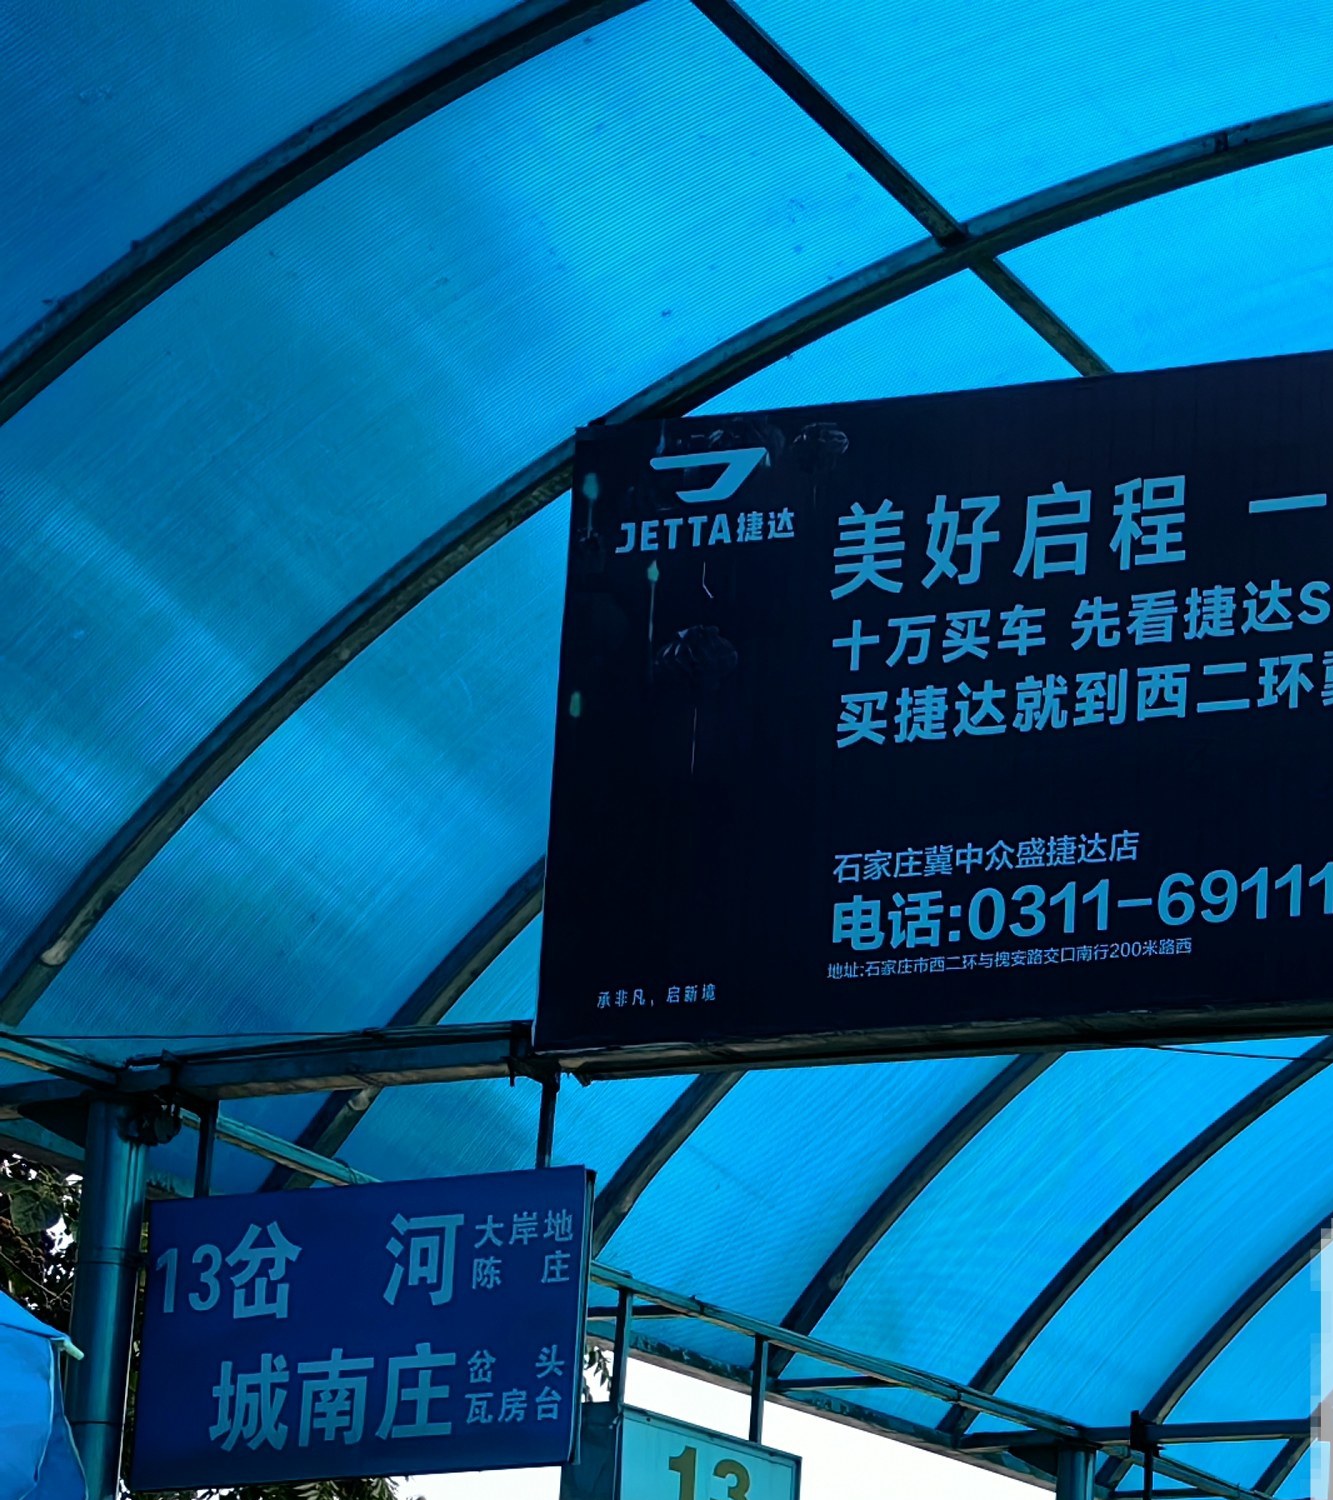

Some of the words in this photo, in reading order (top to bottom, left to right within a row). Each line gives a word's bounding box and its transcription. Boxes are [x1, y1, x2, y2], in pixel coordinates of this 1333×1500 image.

[830, 474, 1186, 599] 美好启程
[832, 603, 1047, 674] 十万买车
[833, 830, 1140, 883] 石家庄冀中众盛捷达店
[474, 1208, 574, 1250] 大岸地
[472, 1250, 571, 1291] 陈庄
[467, 1344, 566, 1385] 岔头
[209, 1342, 457, 1452] 城南庄
[464, 1386, 563, 1425] 瓦房台
